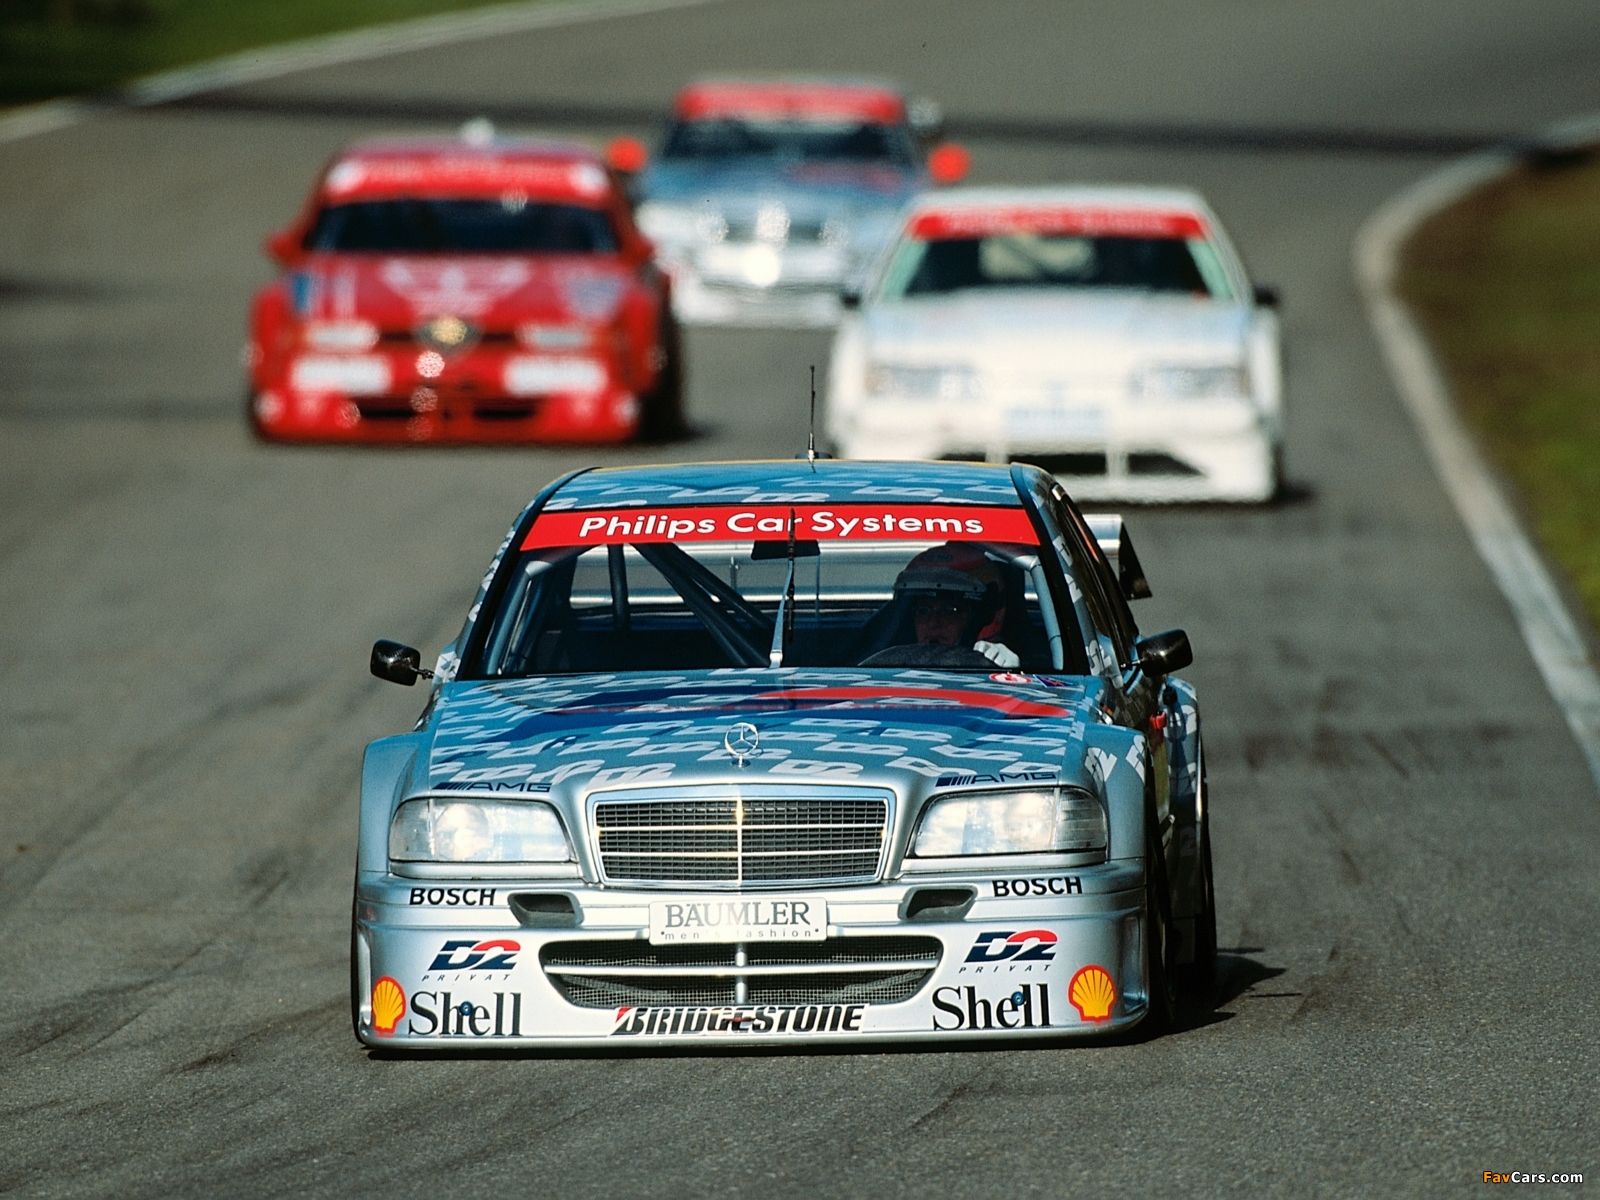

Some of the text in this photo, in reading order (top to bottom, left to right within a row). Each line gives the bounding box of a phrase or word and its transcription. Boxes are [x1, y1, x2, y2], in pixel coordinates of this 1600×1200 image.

[579, 511, 984, 539] Philips Car Systems
[466, 782, 552, 793] AMG
[970, 772, 1056, 785] AMG
[409, 888, 497, 906] BOSCH
[992, 876, 1082, 897] BOSCH
[664, 901, 811, 927] BÄUMLER
[428, 940, 521, 971] D2
[964, 930, 1057, 962] D2
[421, 974, 510, 982] PRIVAT
[959, 964, 1051, 974] PRIVAT
[408, 991, 523, 1037] Shell
[932, 983, 1055, 1030] Shell
[611, 1004, 866, 1036] BRIDGESTONE
